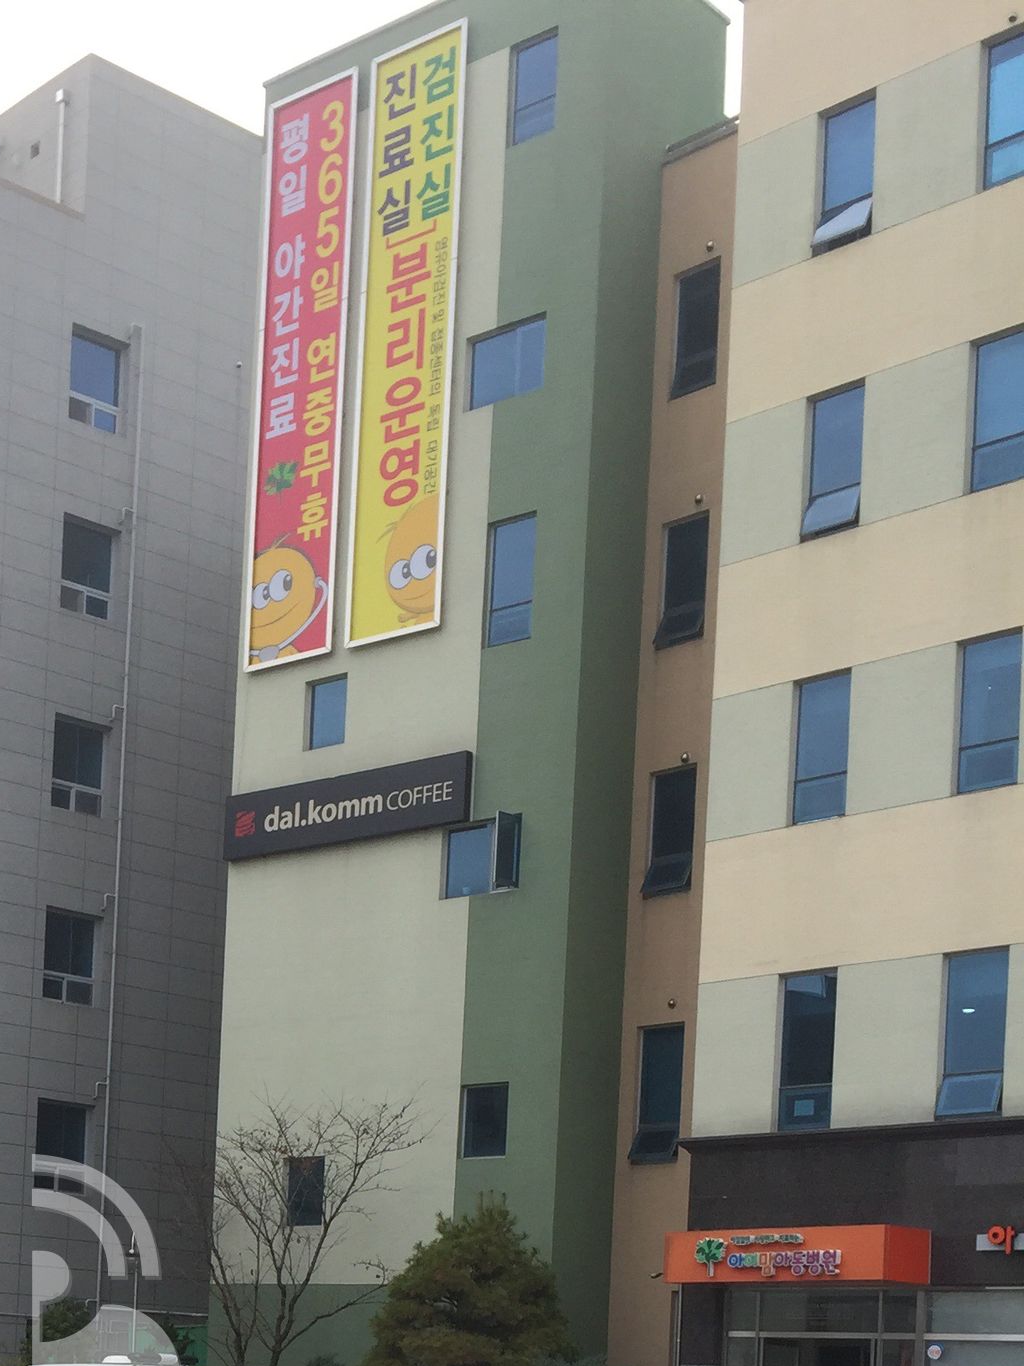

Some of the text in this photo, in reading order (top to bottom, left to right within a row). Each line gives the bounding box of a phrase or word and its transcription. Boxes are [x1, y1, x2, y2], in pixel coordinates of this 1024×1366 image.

[377, 63, 417, 236] 진료실
[417, 46, 456, 221] 검진실
[265, 112, 309, 440] 평일 야간진료
[297, 99, 344, 542] 365일 연중무휴
[379, 242, 432, 508] 분리운영
[264, 780, 454, 832] dal.komm COFFEE
[987, 1225, 1015, 1255] 아
